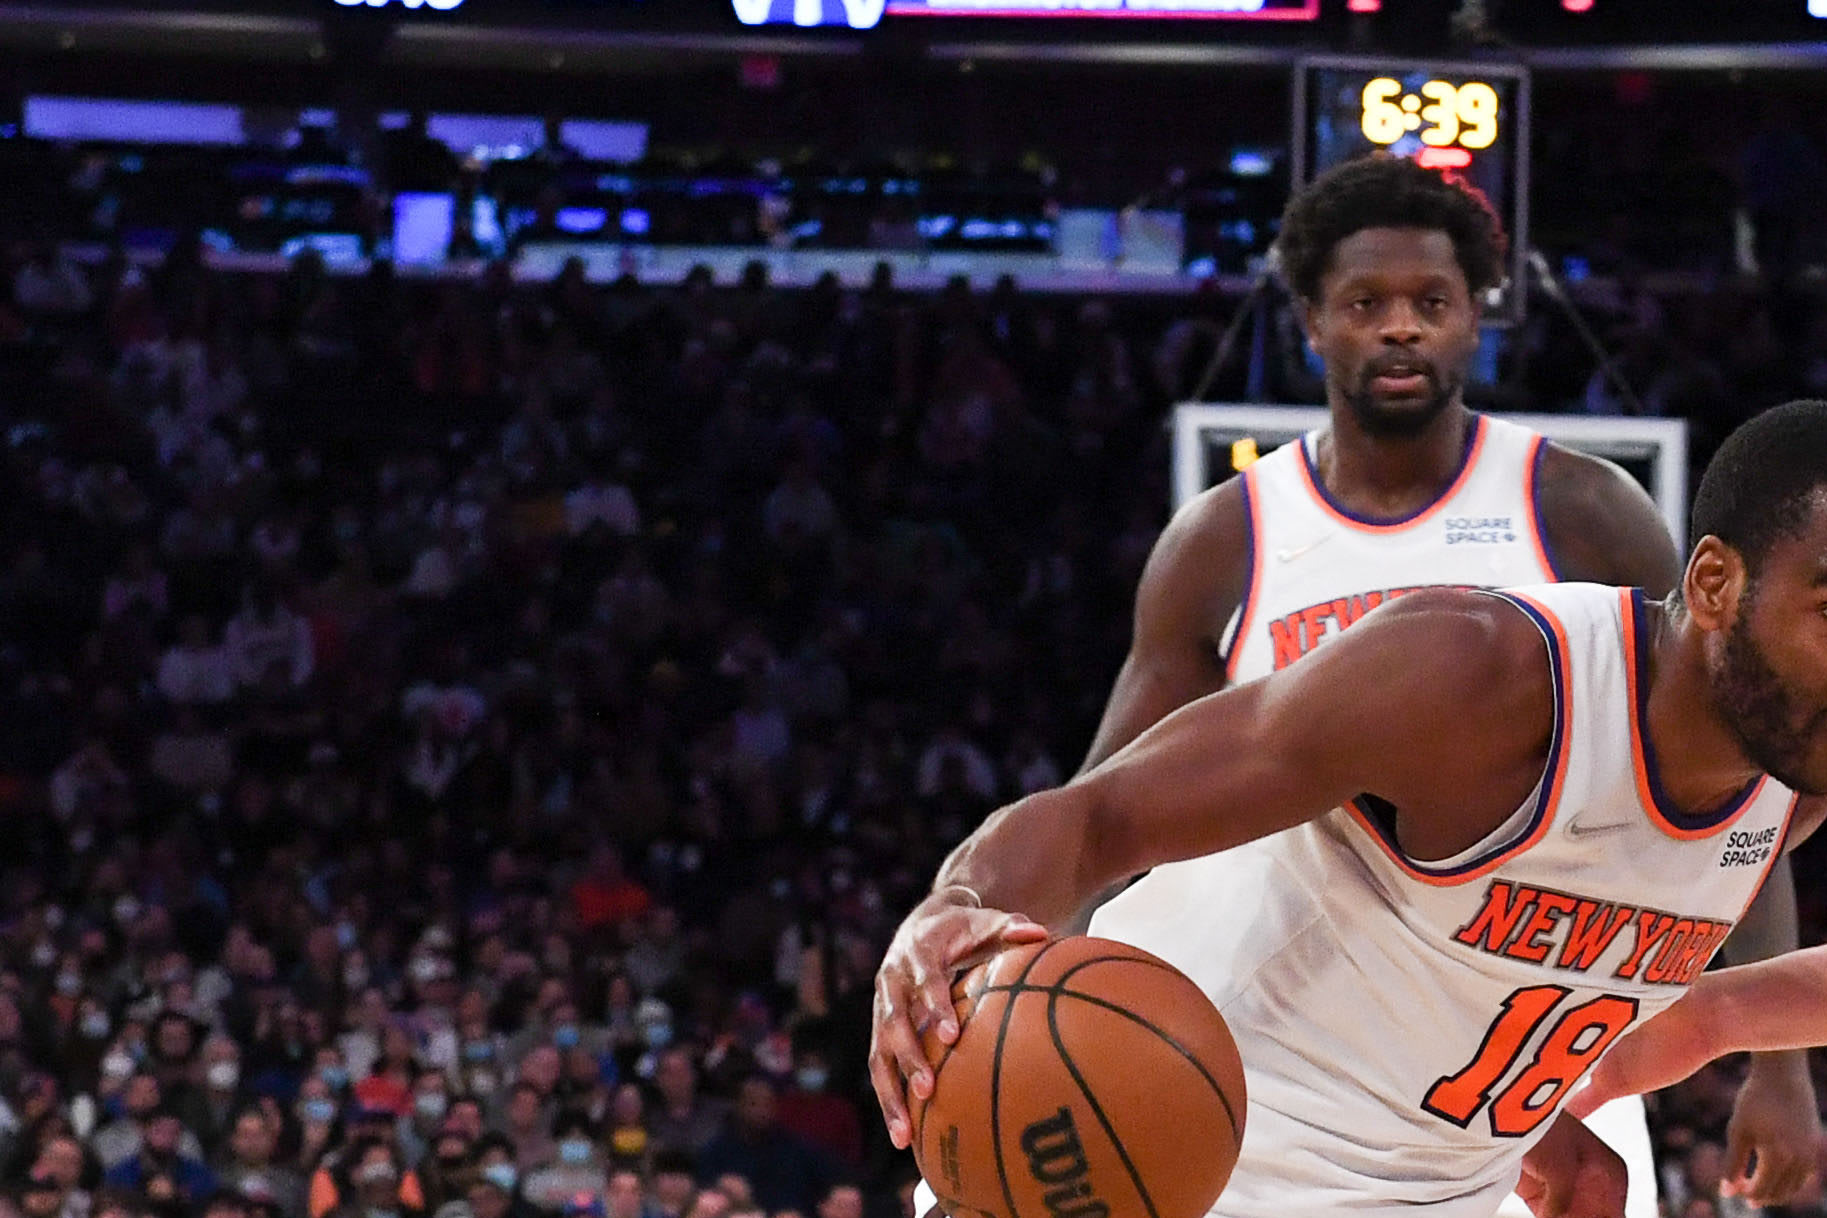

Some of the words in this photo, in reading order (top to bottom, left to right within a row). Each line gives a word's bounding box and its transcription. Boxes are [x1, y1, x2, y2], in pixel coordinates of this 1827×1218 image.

[1361, 77, 1498, 149] 6:39
[1445, 517, 1511, 530] SQUARE
[1446, 531, 1499, 545] SPACE
[1726, 826, 1778, 849] SQUARE
[1719, 848, 1762, 868] SPACE
[1449, 877, 1637, 976] NEW
[1420, 983, 1641, 1138] 18
